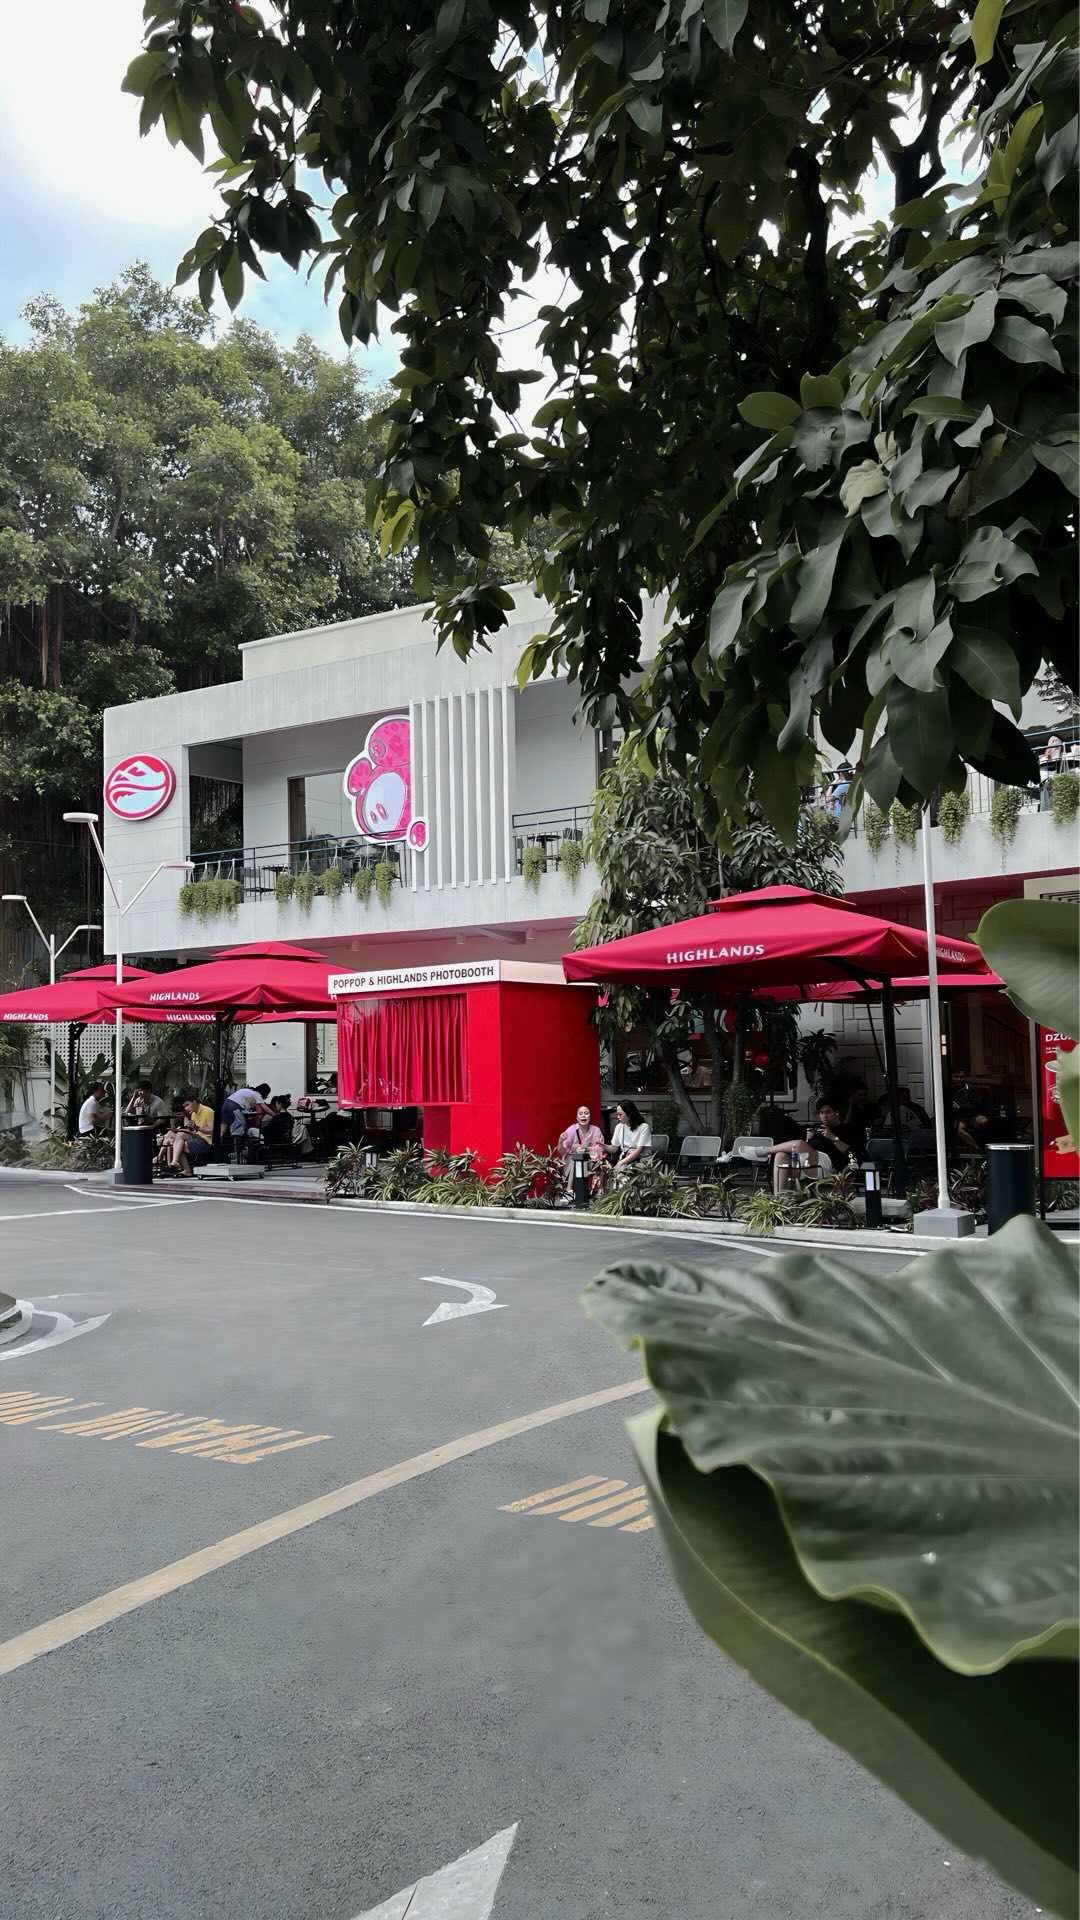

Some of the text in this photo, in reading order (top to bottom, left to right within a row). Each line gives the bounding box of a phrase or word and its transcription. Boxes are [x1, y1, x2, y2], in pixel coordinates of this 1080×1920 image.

[666, 944, 765, 964] HIGHLANDS
[333, 966, 494, 989] POPPOP & HIGHLANDS PHOTOBOOTH
[149, 992, 200, 1002] HIGHLANDS
[3, 1013, 49, 1021] HIGHLANDS
[1045, 1033, 1072, 1042] DZU
